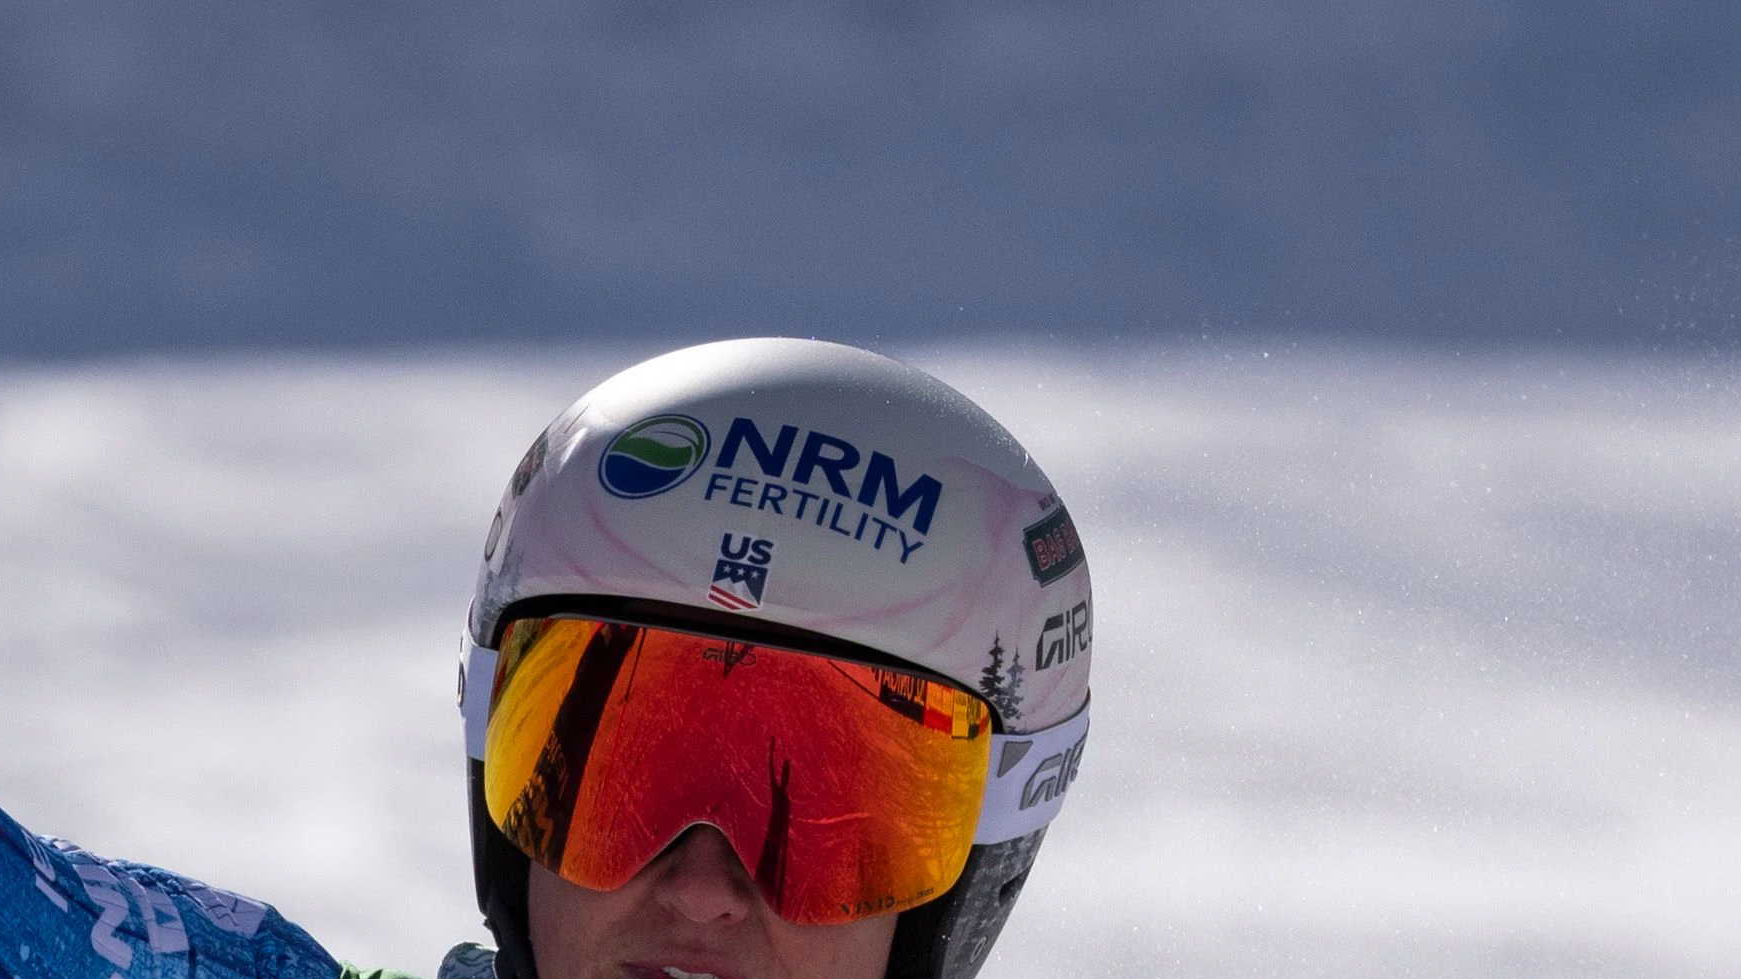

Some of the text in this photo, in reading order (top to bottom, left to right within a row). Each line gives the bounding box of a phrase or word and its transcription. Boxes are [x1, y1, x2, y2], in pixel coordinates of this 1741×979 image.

[704, 473, 925, 565] FERTILITY
[714, 416, 943, 536] NRM
[720, 533, 774, 566] US
